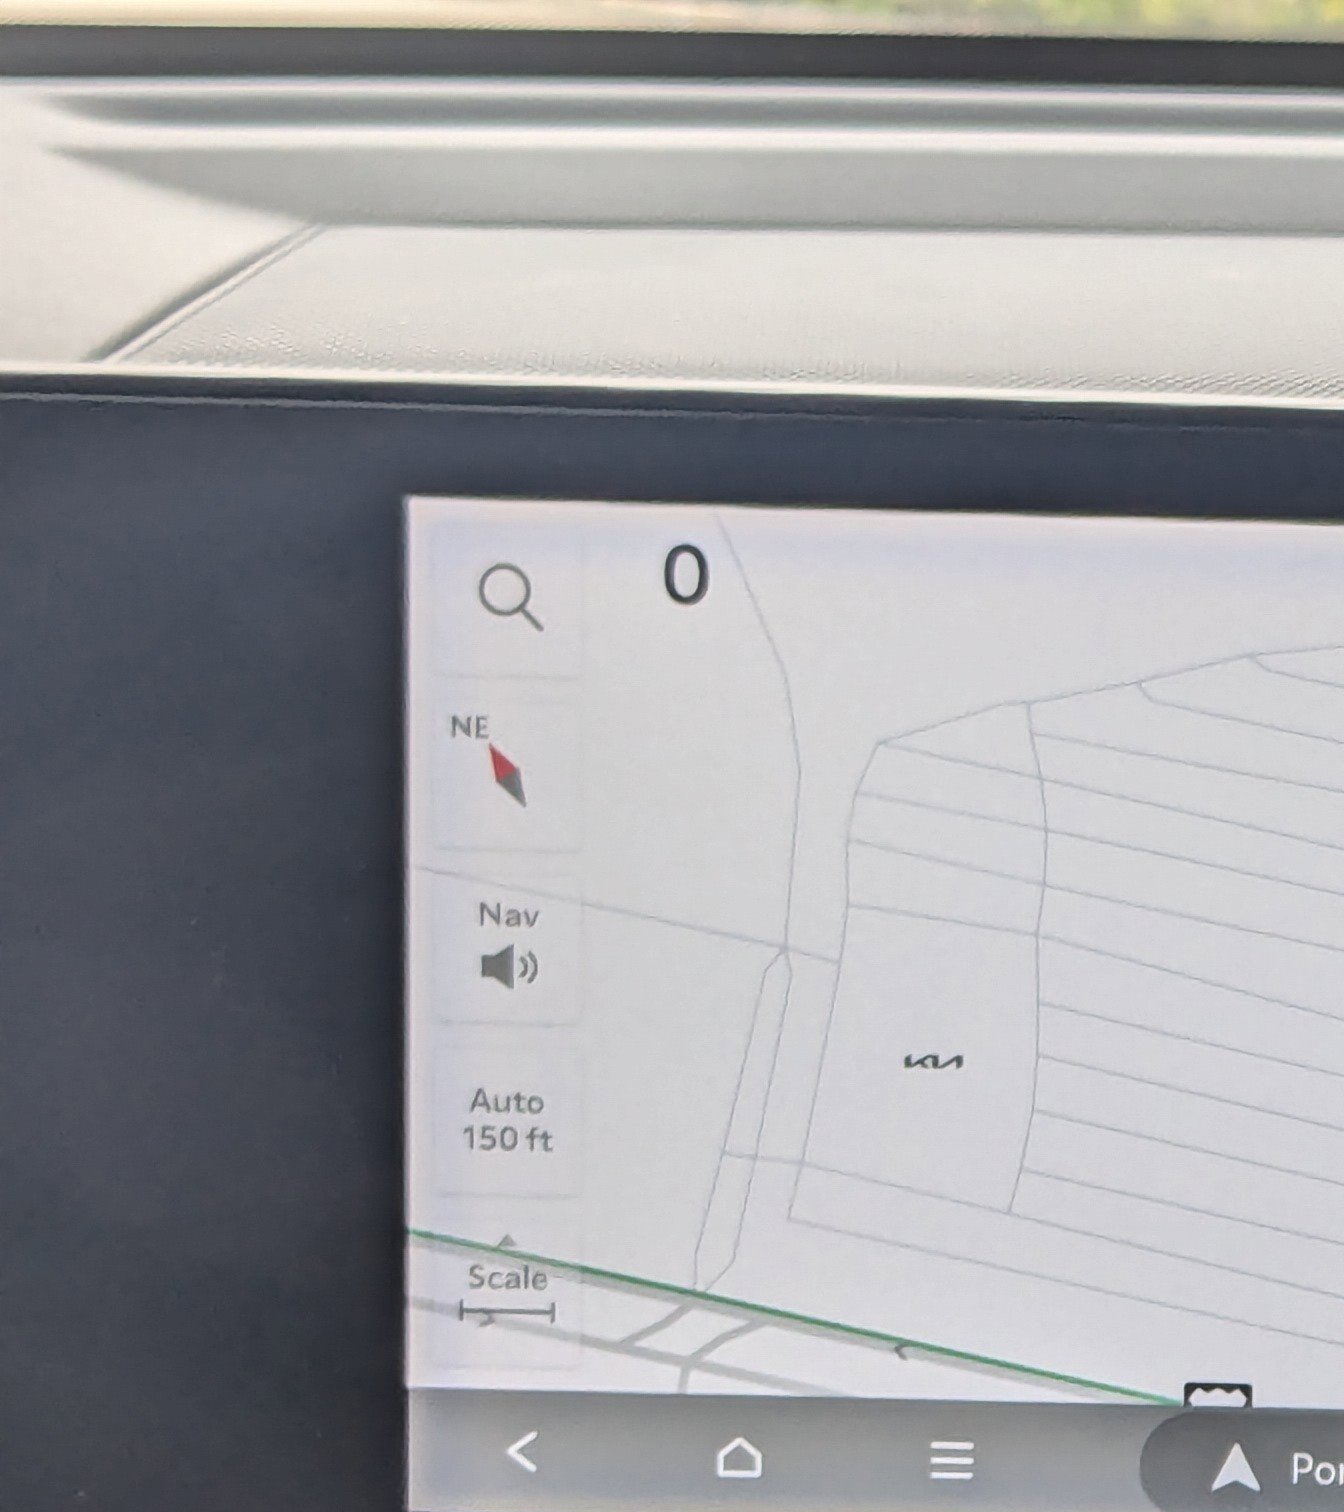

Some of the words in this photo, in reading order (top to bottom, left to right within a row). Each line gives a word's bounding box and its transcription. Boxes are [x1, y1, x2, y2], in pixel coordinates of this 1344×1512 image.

[663, 543, 709, 605] 0
[451, 715, 488, 739] NE
[479, 901, 539, 928] Nav
[470, 1087, 545, 1115] Auto
[463, 1125, 518, 1152] 150
[525, 1126, 553, 1152] ft
[469, 1264, 548, 1291] Scale
